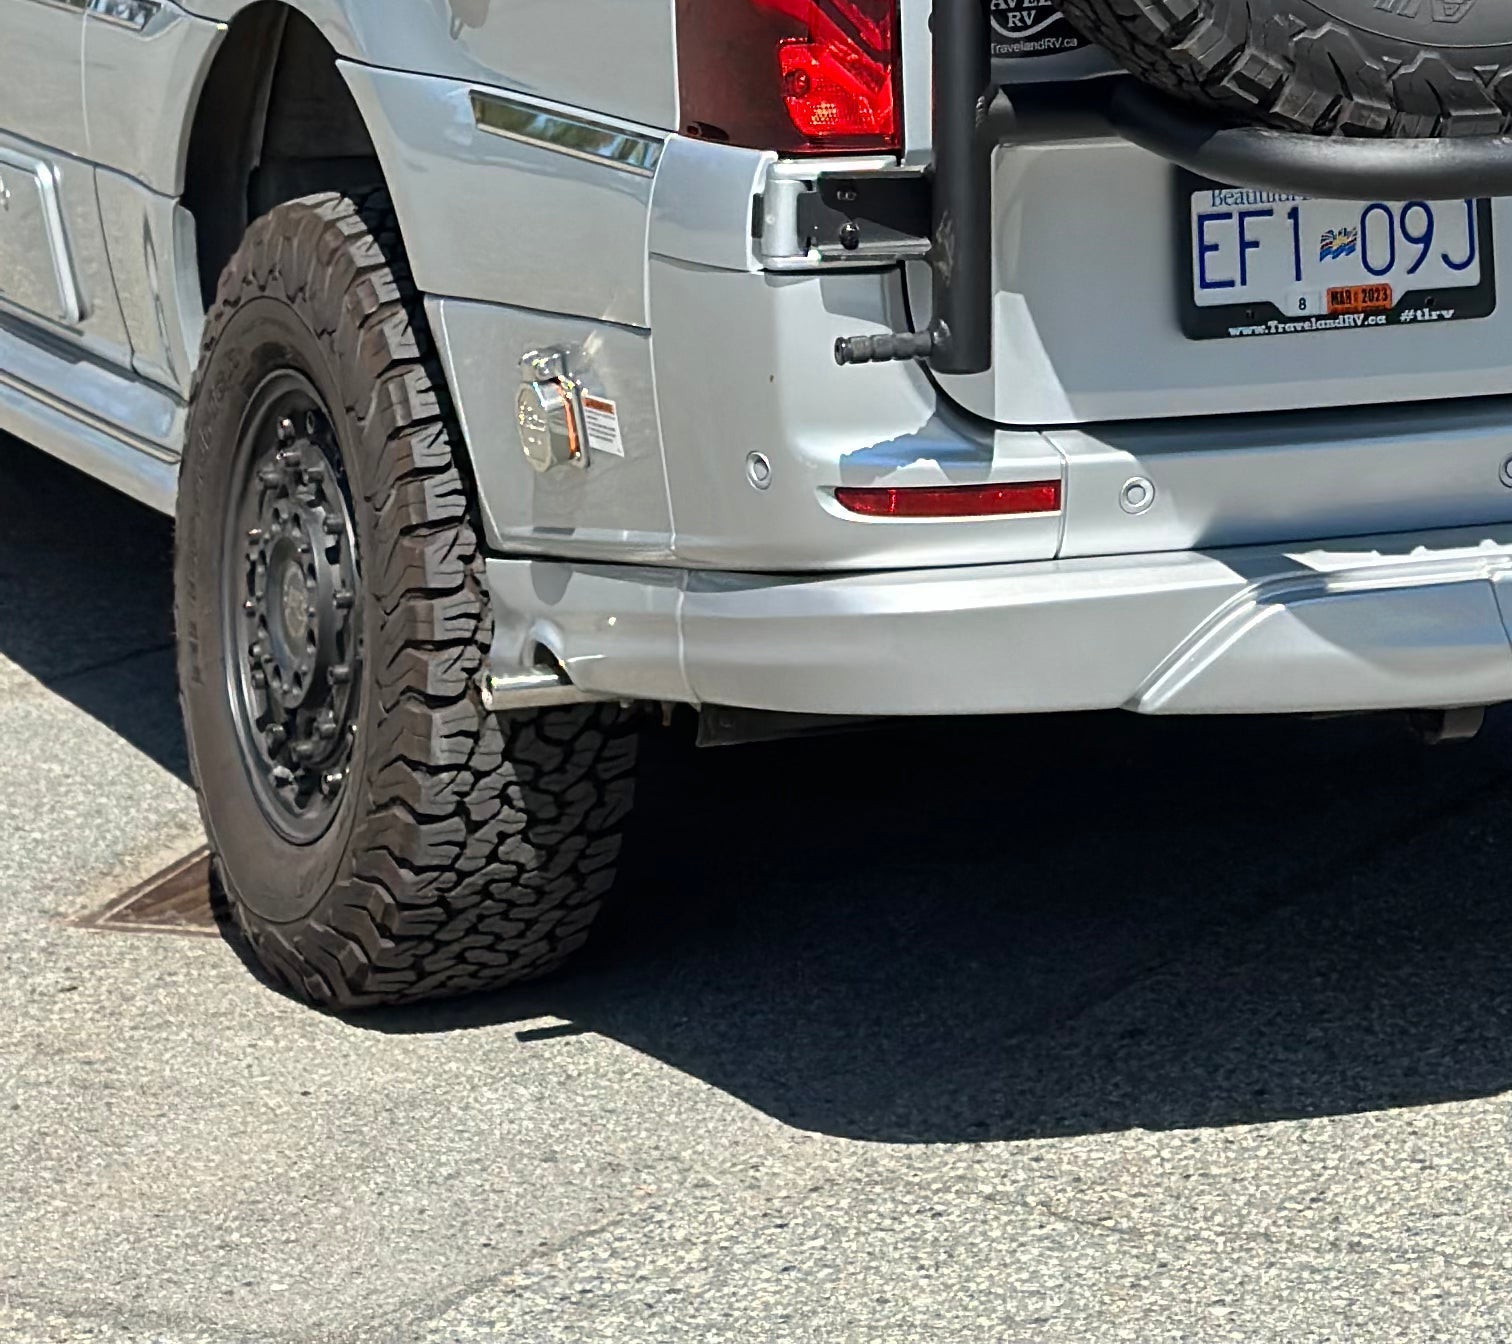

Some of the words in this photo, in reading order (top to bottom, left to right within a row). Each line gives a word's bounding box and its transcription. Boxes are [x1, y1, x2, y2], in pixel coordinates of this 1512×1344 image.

[1007, 10, 1036, 28] RV
[1197, 206, 1303, 289] EF1
[1360, 199, 1475, 276] 09J
[1298, 297, 1307, 310] 8
[1331, 289, 1351, 305] MAR
[1361, 287, 1389, 303] 2023
[1228, 313, 1387, 337] www.TravelandRV.ca
